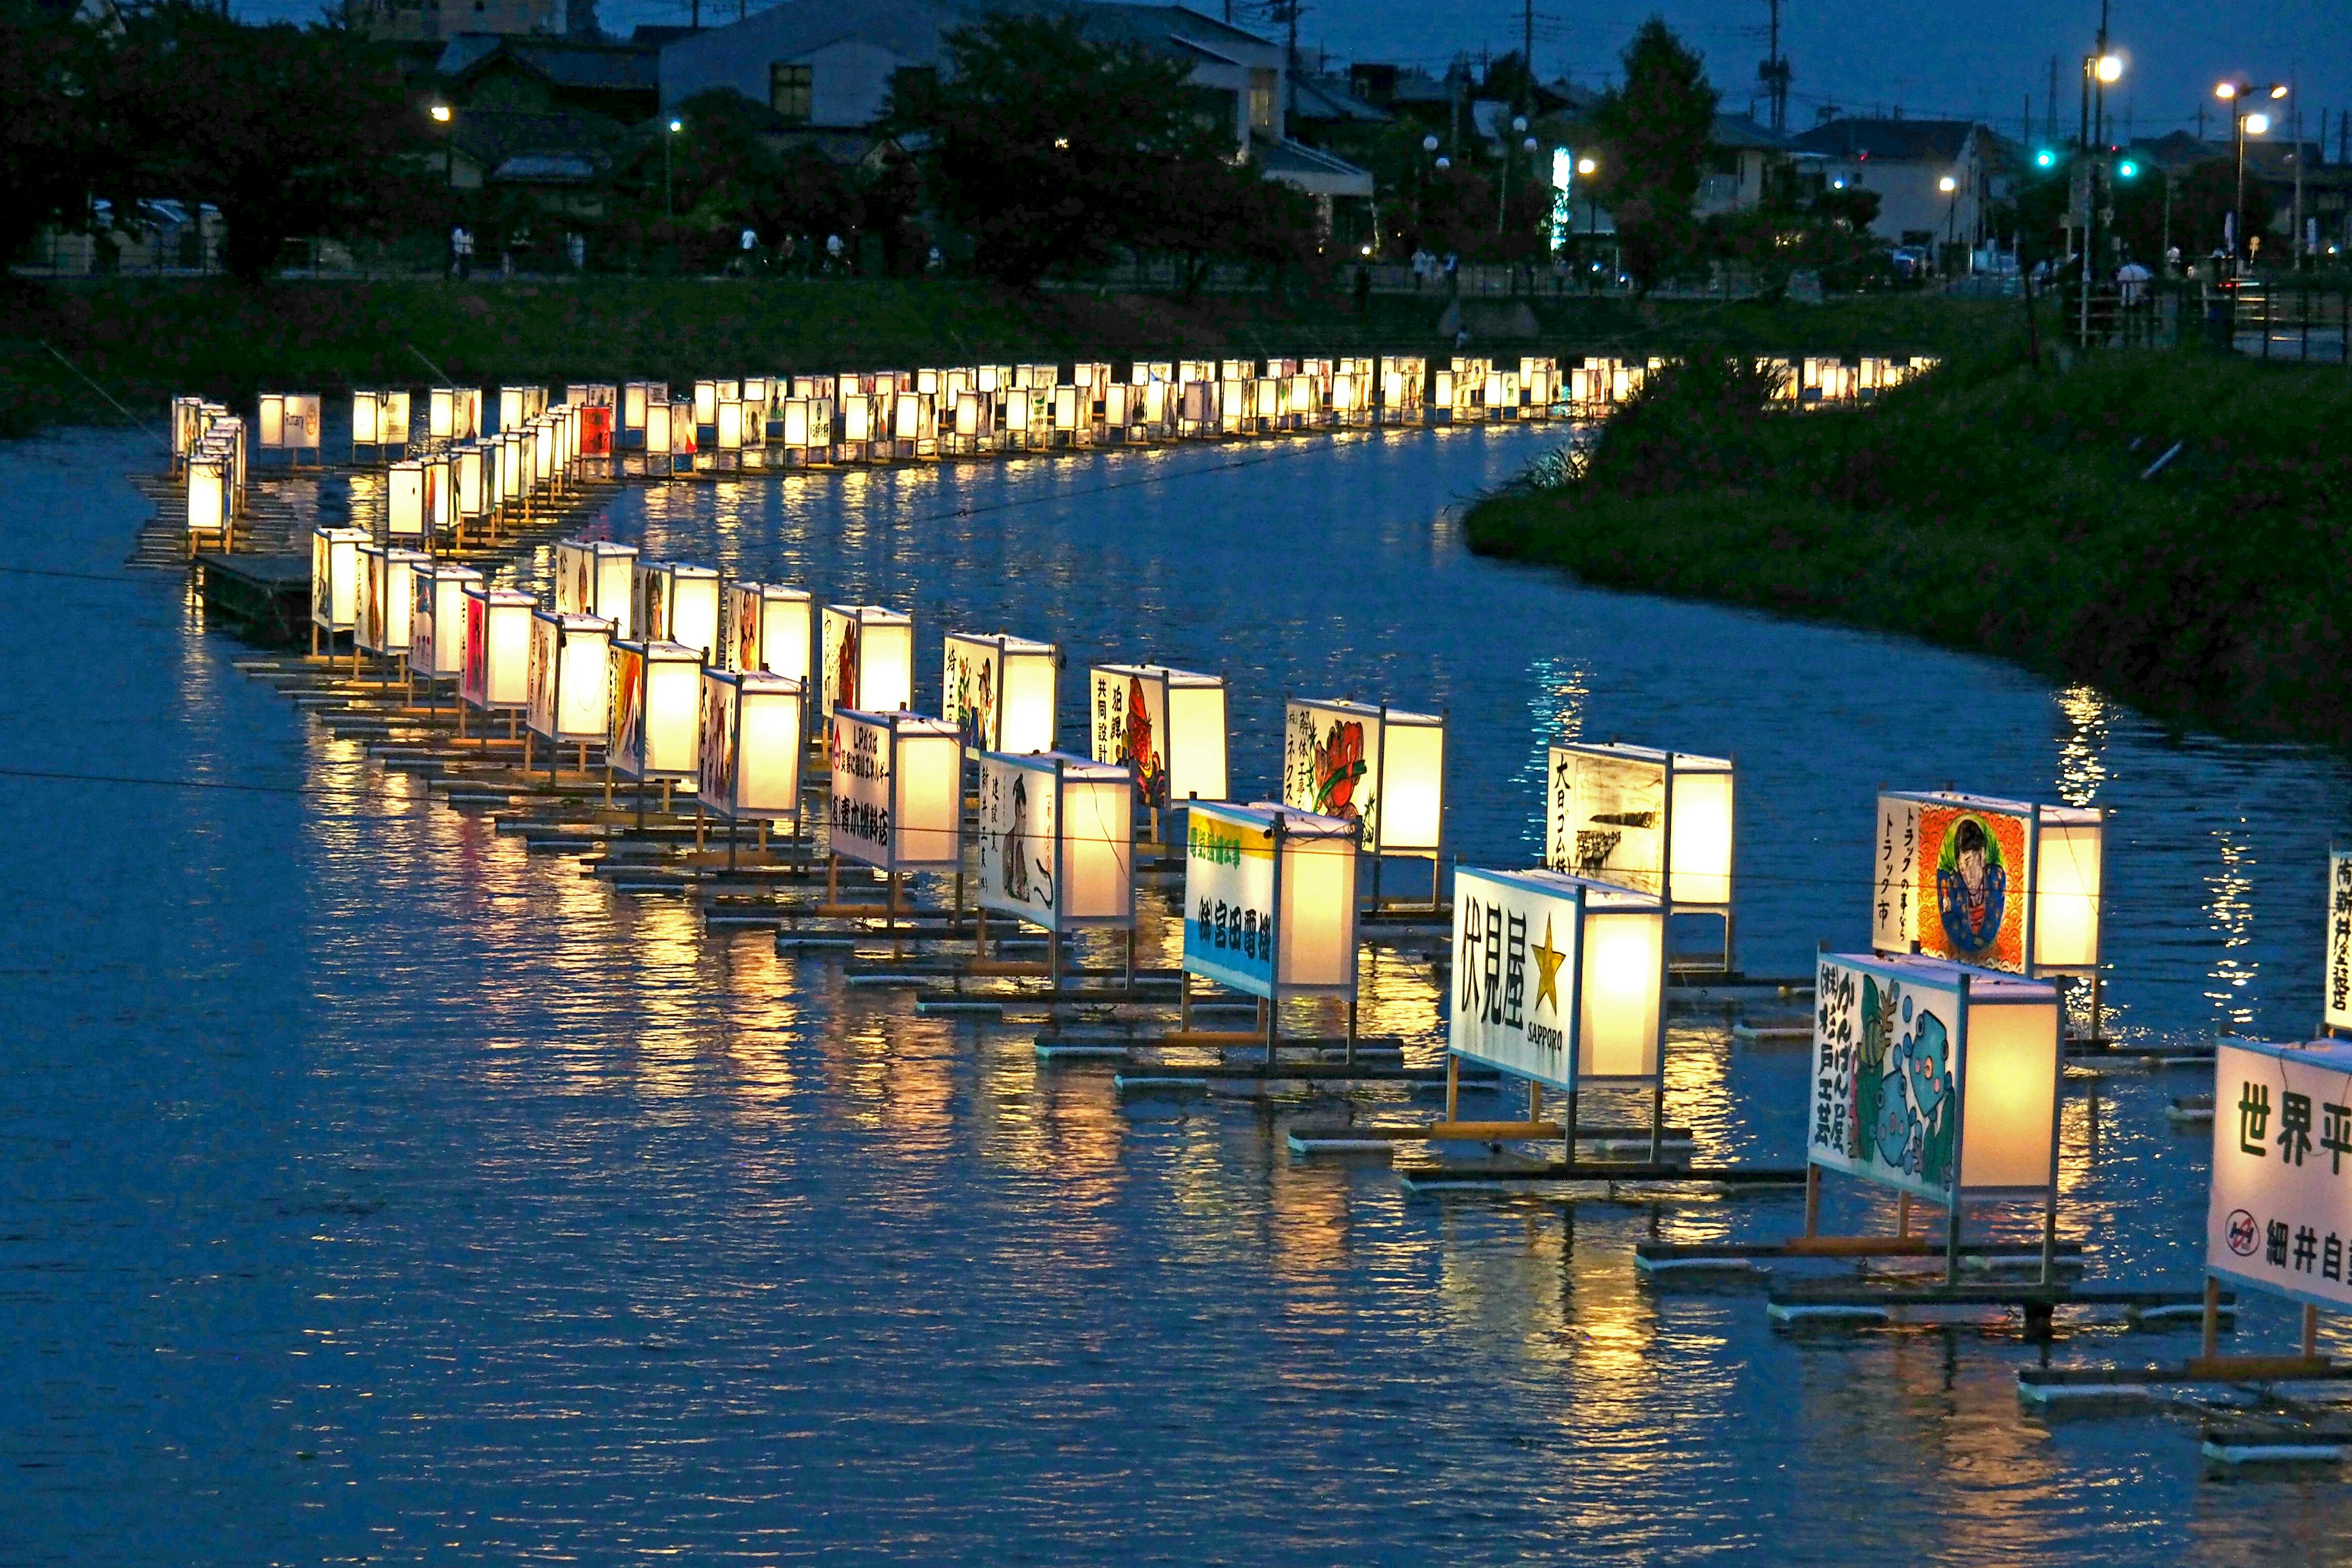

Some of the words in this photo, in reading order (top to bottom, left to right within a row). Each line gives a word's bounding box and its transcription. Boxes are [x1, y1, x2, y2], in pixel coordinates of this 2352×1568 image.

[853, 725, 878, 754] LPガスは
[1098, 678, 1107, 764] 共同設計
[1878, 812, 1893, 930] トラック市
[1899, 807, 1913, 941] トラックの事なら
[1461, 892, 1526, 1030] 伏見屋
[1528, 1022, 1562, 1052] SAPPORO
[1830, 972, 1854, 1156] かんばん屋
[2238, 1081, 2352, 1175] 世界平
[2266, 1218, 2352, 1285] 細井自
